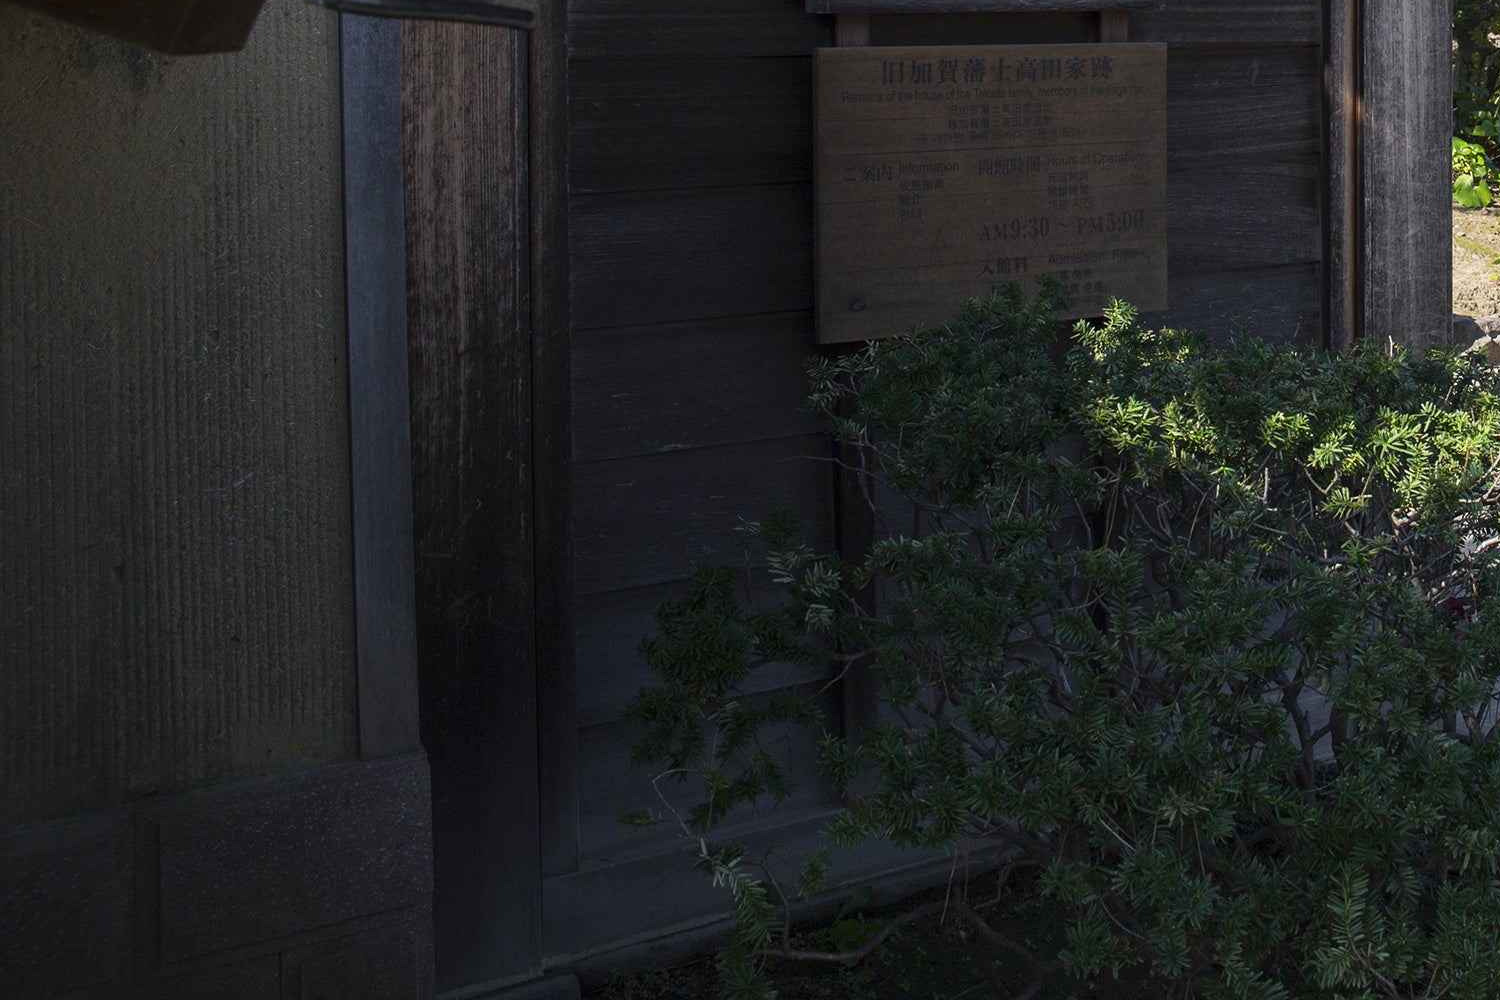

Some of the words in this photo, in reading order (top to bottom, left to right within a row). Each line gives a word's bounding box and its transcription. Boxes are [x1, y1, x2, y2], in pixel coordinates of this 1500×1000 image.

[882, 56, 1113, 86] 旧加賀藩士高田家跡
[842, 91, 884, 103] Remains
[886, 90, 896, 102] of
[898, 90, 913, 102] the
[915, 89, 944, 101] house
[945, 89, 955, 100] of
[957, 88, 972, 100] the
[899, 161, 960, 175] Information
[978, 156, 1041, 176] 開館時間
[1047, 154, 1077, 166] Hours
[1080, 153, 1091, 165] of
[1093, 150, 1143, 165] Operation
[844, 163, 892, 183] ご案内
[976, 256, 1028, 277] 入館料
